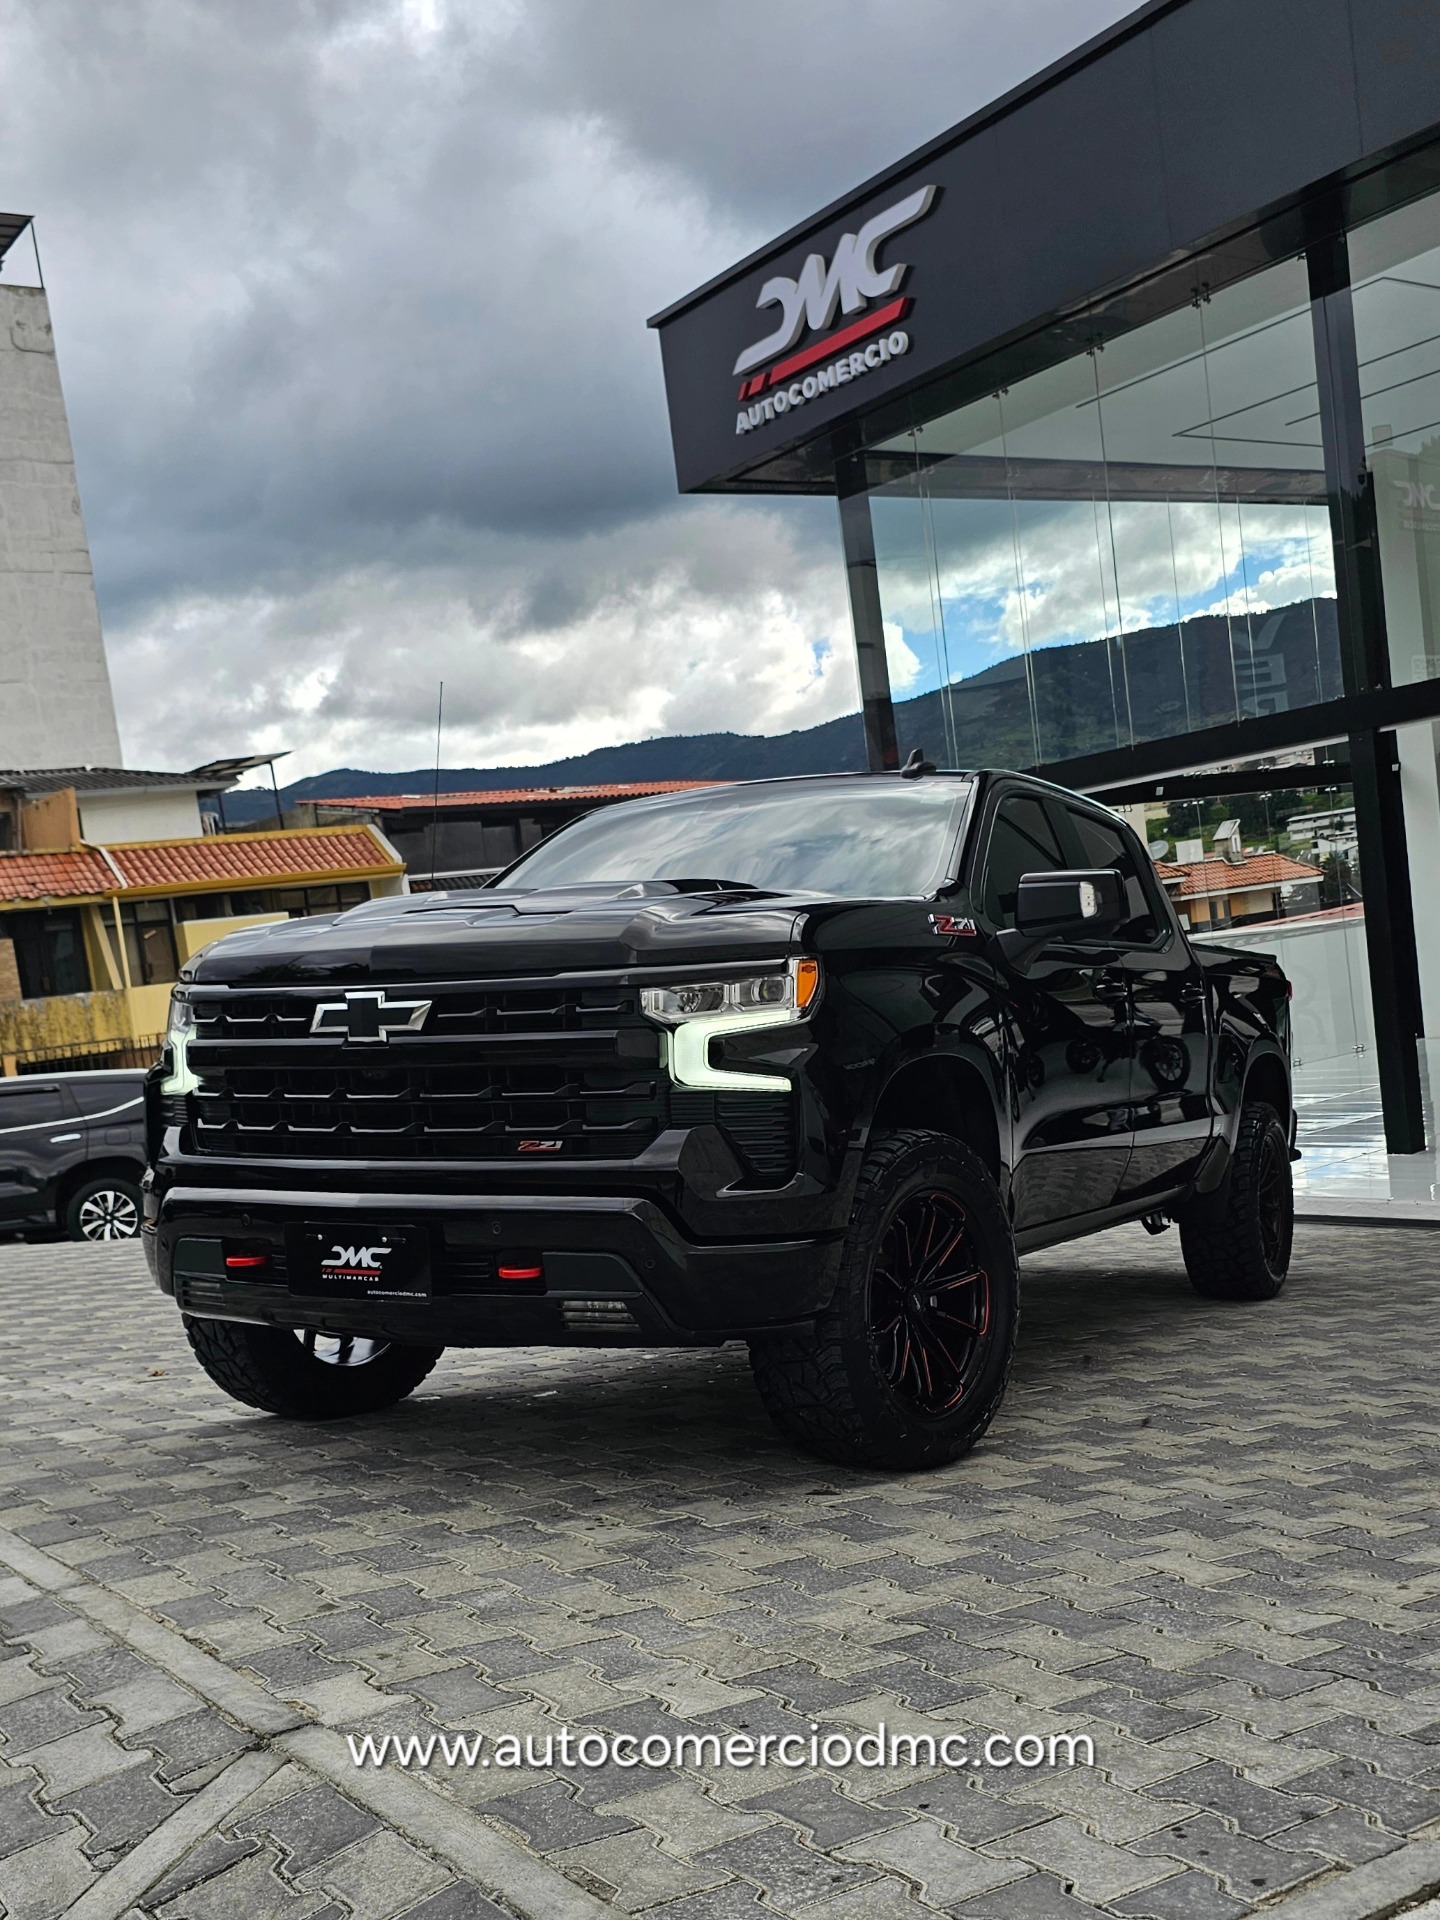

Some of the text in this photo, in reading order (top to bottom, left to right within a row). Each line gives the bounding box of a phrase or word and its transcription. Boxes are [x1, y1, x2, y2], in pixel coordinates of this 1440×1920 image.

[733, 185, 936, 376] DMC
[736, 331, 909, 435] AUTOCOMERCIO
[928, 913, 977, 936] Z71
[518, 1140, 563, 1152] Z71
[321, 1245, 392, 1267] DMC
